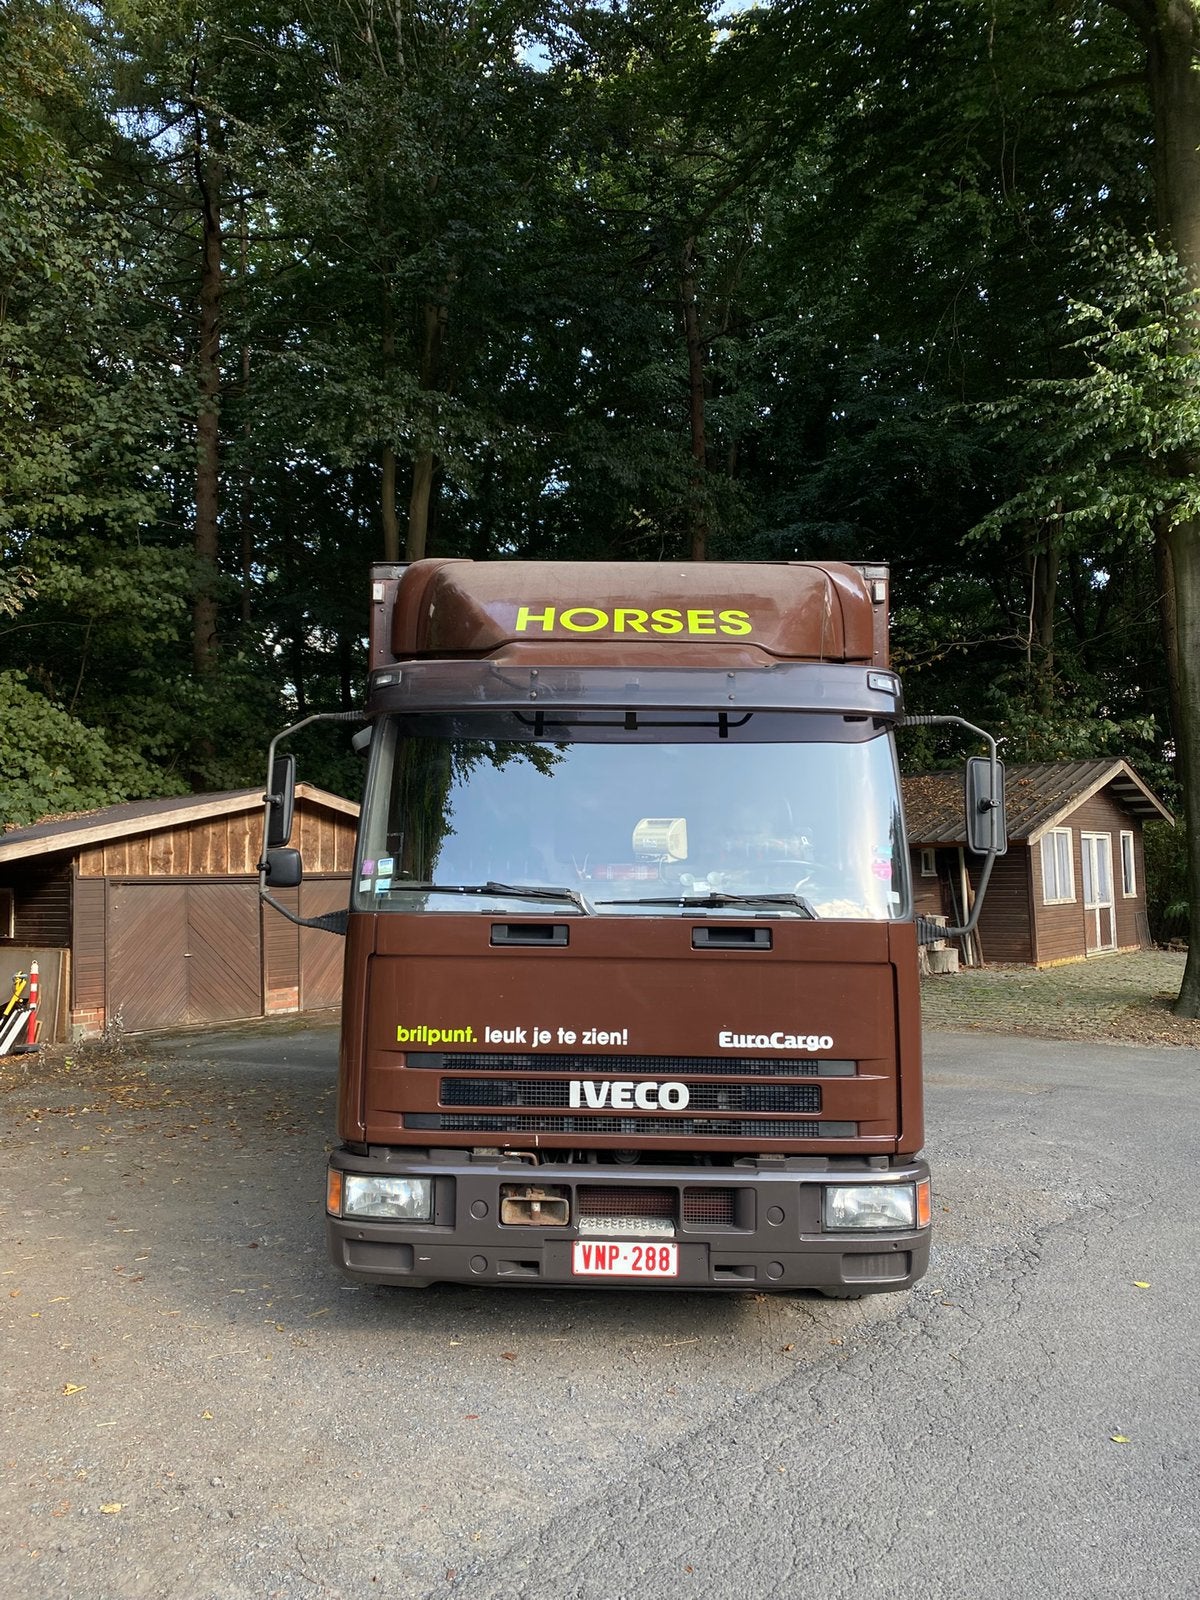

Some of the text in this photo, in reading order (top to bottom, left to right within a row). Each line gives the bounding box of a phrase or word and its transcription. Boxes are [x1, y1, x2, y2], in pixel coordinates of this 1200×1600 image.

[515, 606, 753, 636] HORSES
[396, 1025, 629, 1048] brilpunt. leuk je te zien!
[718, 1031, 834, 1052] EuroCargo
[568, 1080, 690, 1110] IVECO
